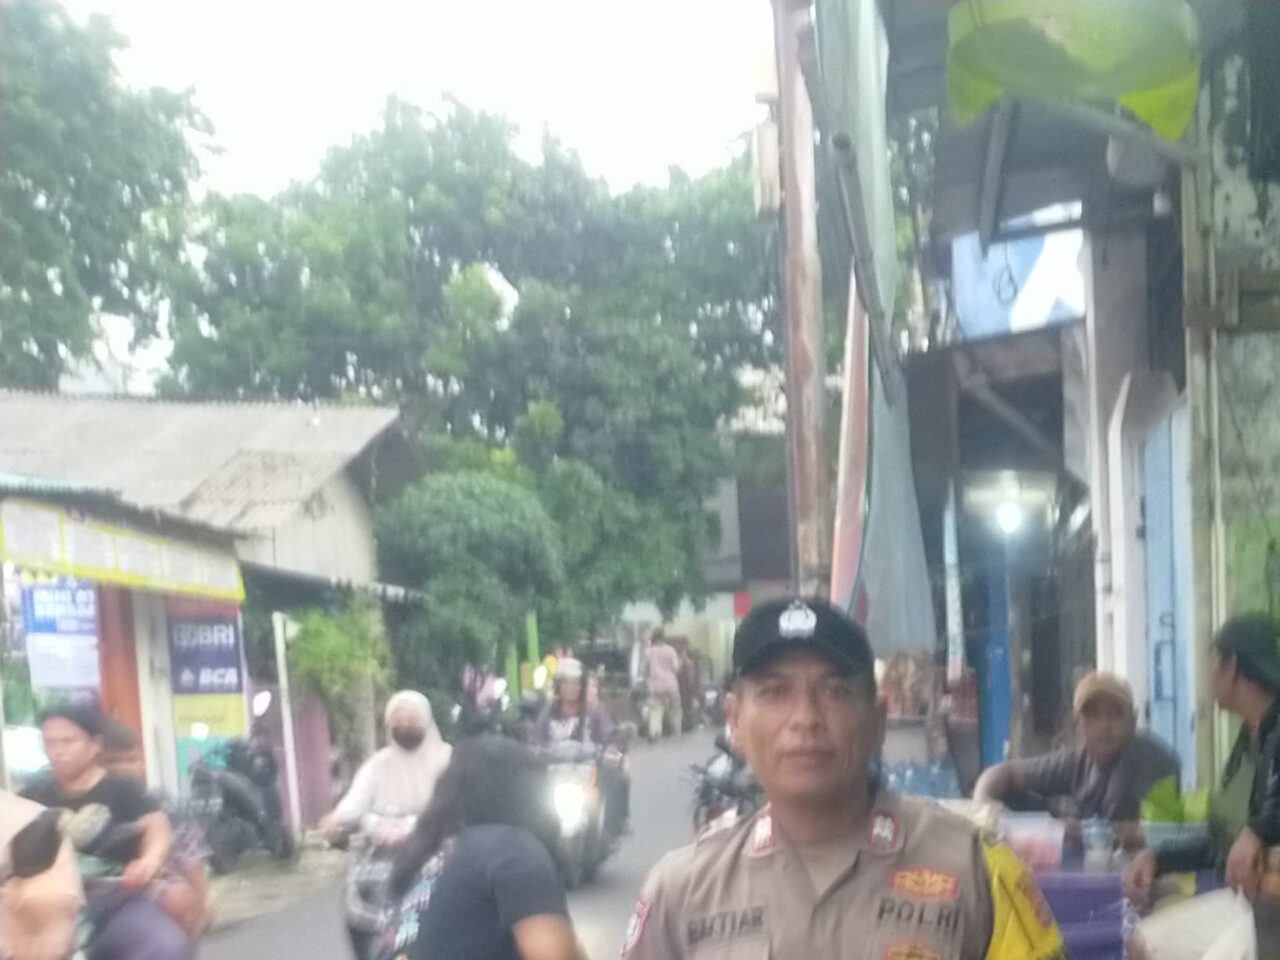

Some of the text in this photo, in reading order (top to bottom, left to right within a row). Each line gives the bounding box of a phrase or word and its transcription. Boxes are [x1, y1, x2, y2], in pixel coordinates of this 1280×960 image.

[199, 623, 235, 647] BRI
[199, 667, 239, 688] BCA
[877, 898, 960, 929] POLRI
